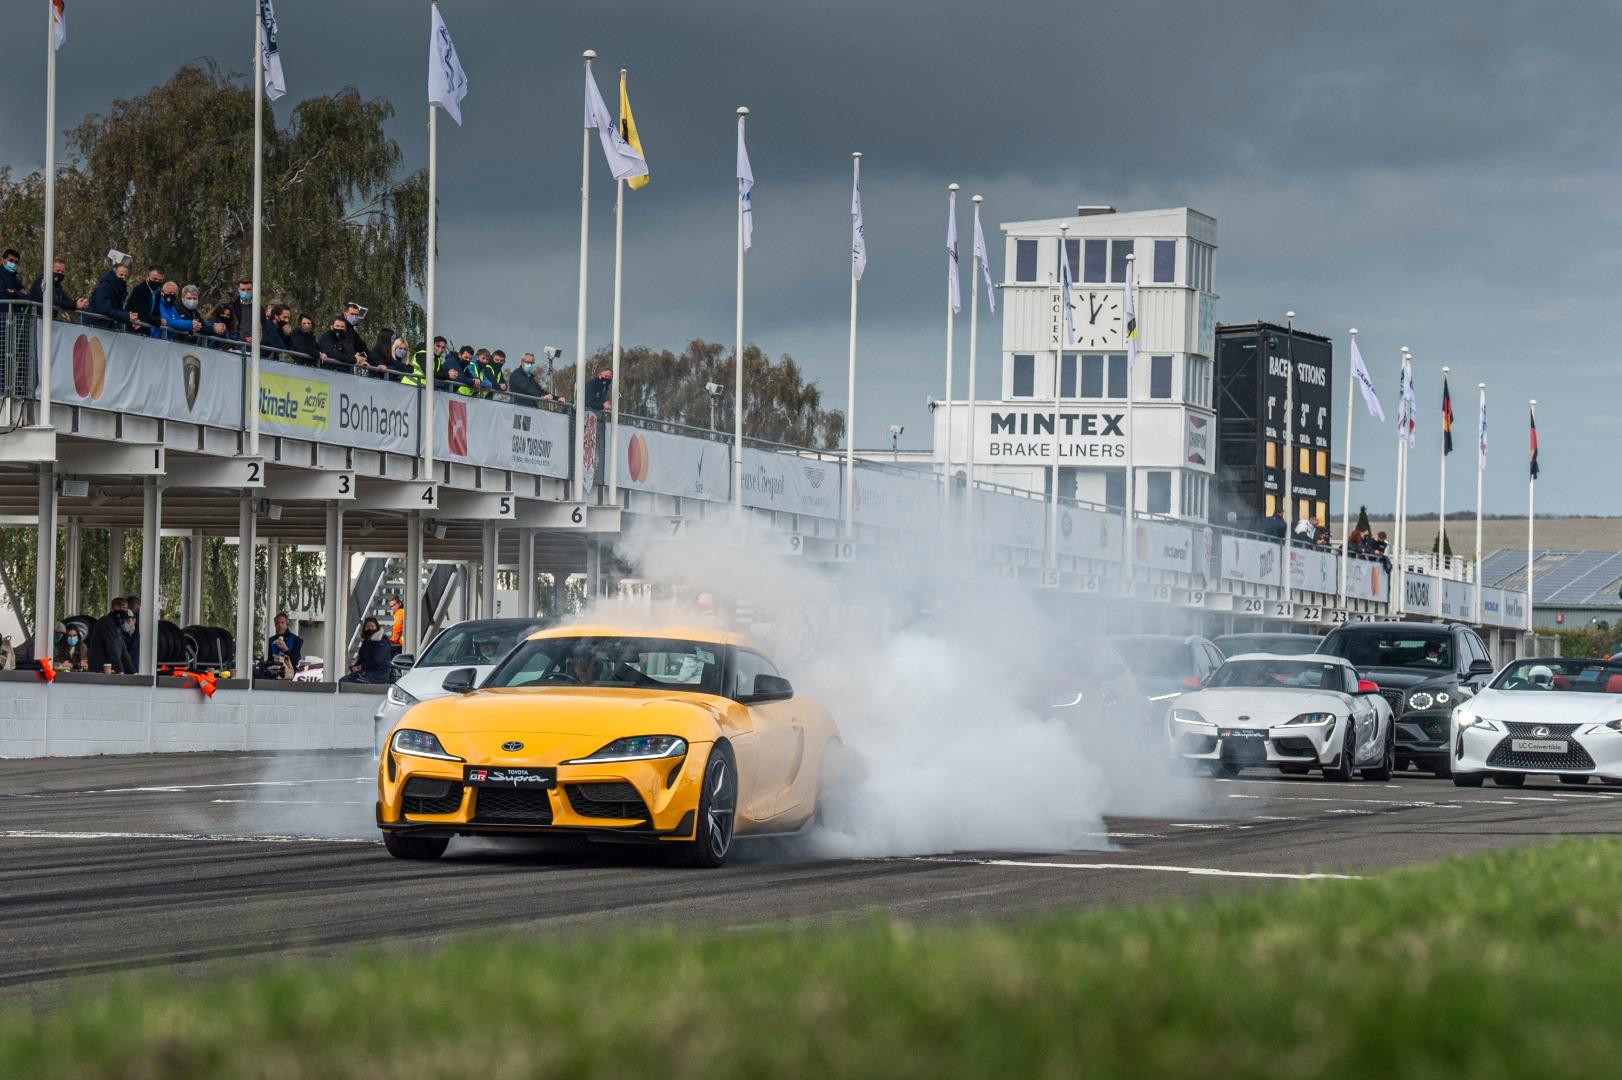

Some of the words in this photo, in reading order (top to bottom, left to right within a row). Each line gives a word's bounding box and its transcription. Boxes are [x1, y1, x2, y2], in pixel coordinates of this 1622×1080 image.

[1269, 356, 1288, 378] RACE
[257, 387, 298, 419] ltimate
[303, 395, 327, 409] ACTIVE
[339, 393, 409, 438] Bonhams
[990, 412, 1124, 437] MINTEX
[512, 434, 526, 454] GRAN
[527, 437, 552, 458] TURISMO
[990, 442, 1051, 457] BRAKE
[1057, 444, 1125, 458] LINERS
[246, 462, 260, 483] 2
[338, 475, 351, 495] 3
[421, 486, 435, 505] 4
[499, 497, 511, 515] 5
[570, 506, 583, 524] 6
[670, 520, 681, 536] 7
[790, 536, 801, 553] 9
[834, 543, 853, 559] 10
[1042, 571, 1058, 585] 15
[1080, 578, 1096, 590] 16
[1153, 586, 1169, 599] 18
[1188, 591, 1203, 603] 19
[1406, 579, 1430, 608] RANDOX
[1244, 599, 1262, 612] 20
[1276, 604, 1291, 615] 21
[1303, 608, 1319, 619] 22
[1332, 611, 1347, 623] 23
[469, 773, 487, 782] GR
[488, 771, 549, 787] Supra
